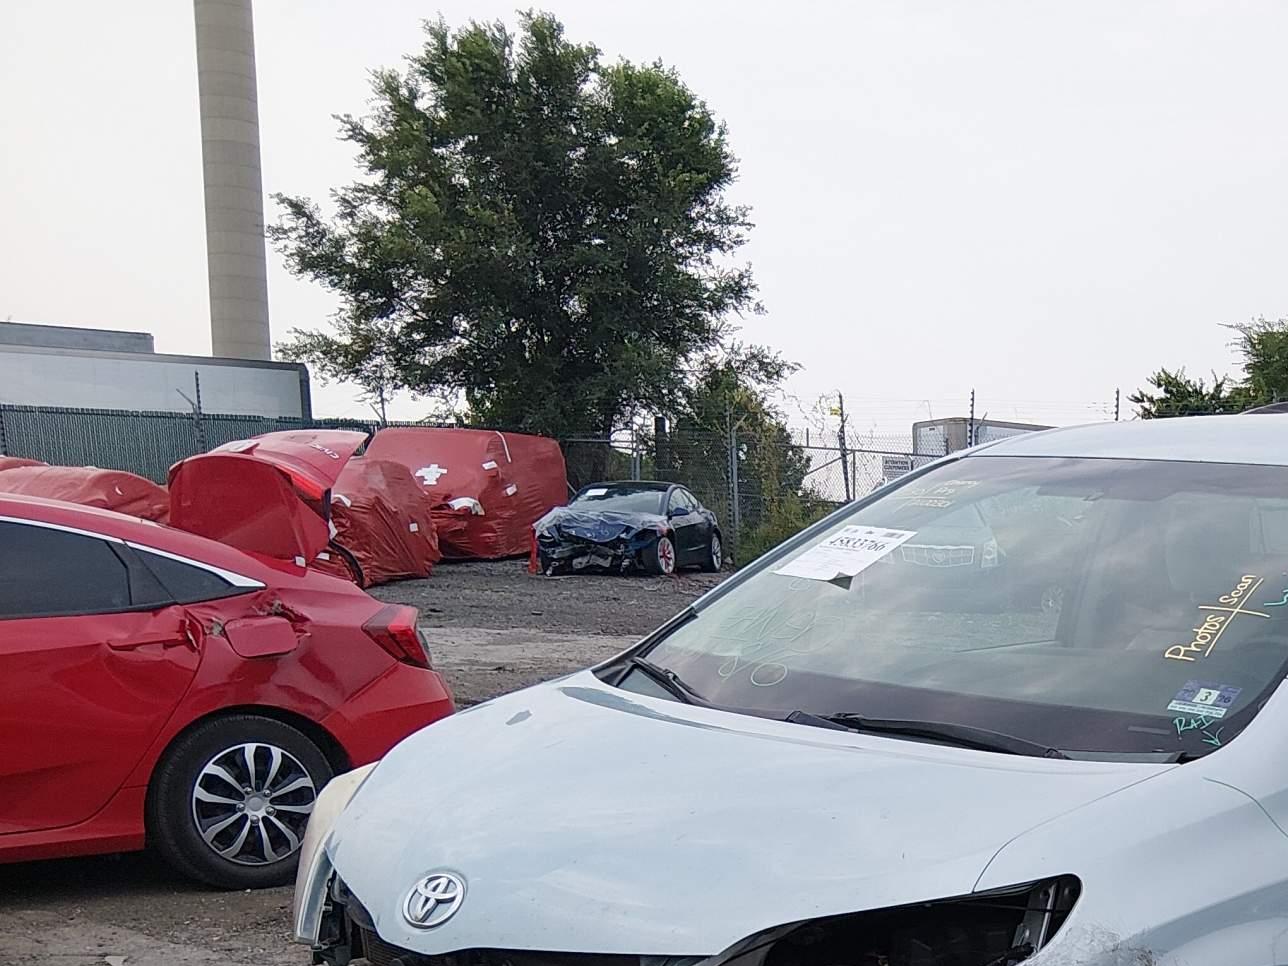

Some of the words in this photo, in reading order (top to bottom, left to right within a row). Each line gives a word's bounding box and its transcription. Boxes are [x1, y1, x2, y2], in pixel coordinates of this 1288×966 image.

[1164, 613, 1226, 662] Photos
[1219, 574, 1257, 606] Scan
[1199, 691, 1213, 702] 3
